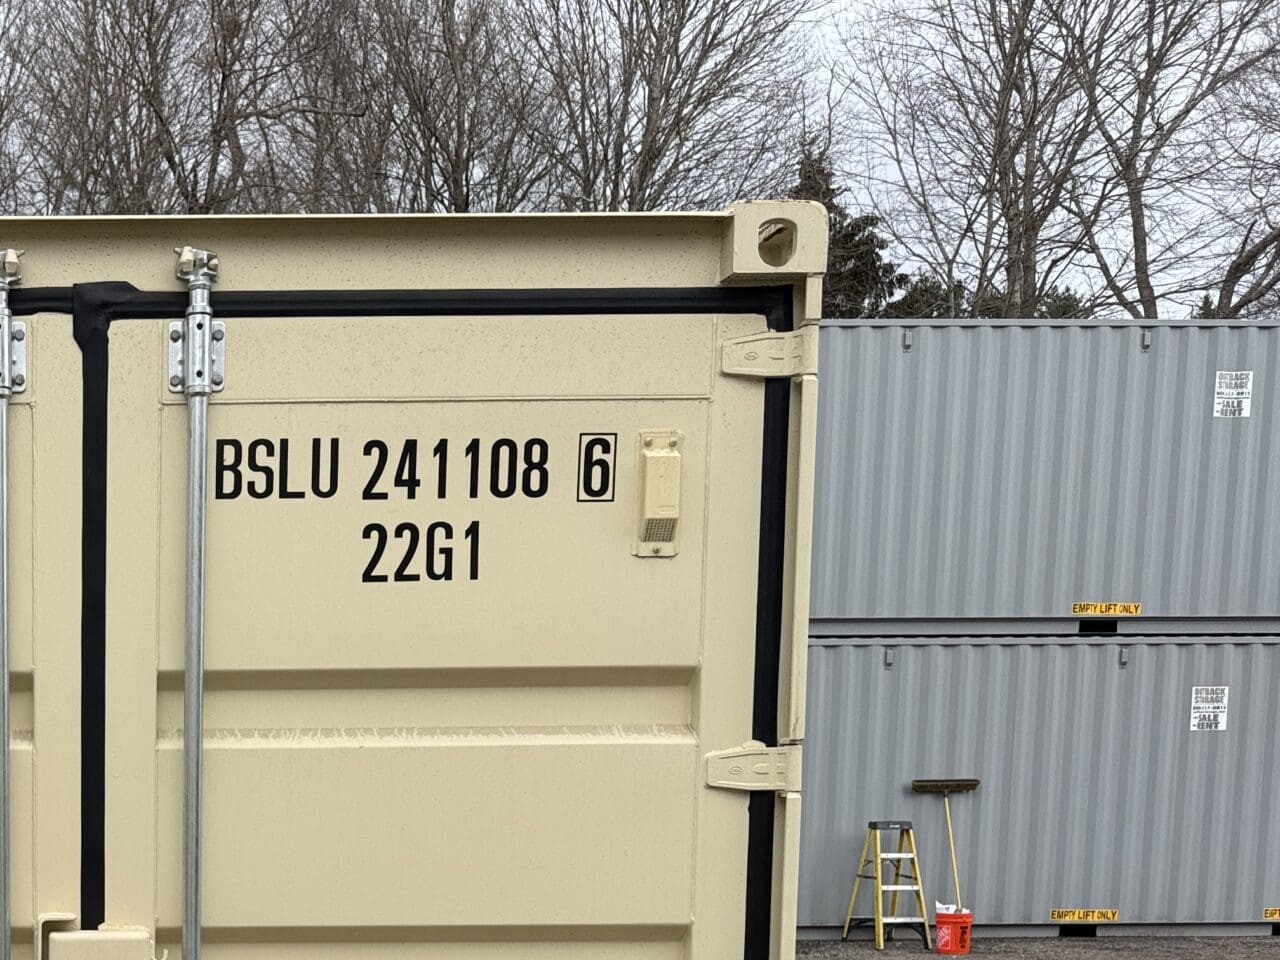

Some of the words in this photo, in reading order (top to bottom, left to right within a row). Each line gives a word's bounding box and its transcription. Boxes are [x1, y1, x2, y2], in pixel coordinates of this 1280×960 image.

[215, 438, 339, 500] BSLU
[361, 438, 549, 500] 241108
[583, 438, 612, 498] 6
[361, 521, 480, 582] 22G1
[1100, 603, 1118, 613] LIFT
[1078, 910, 1096, 919] LIFT
